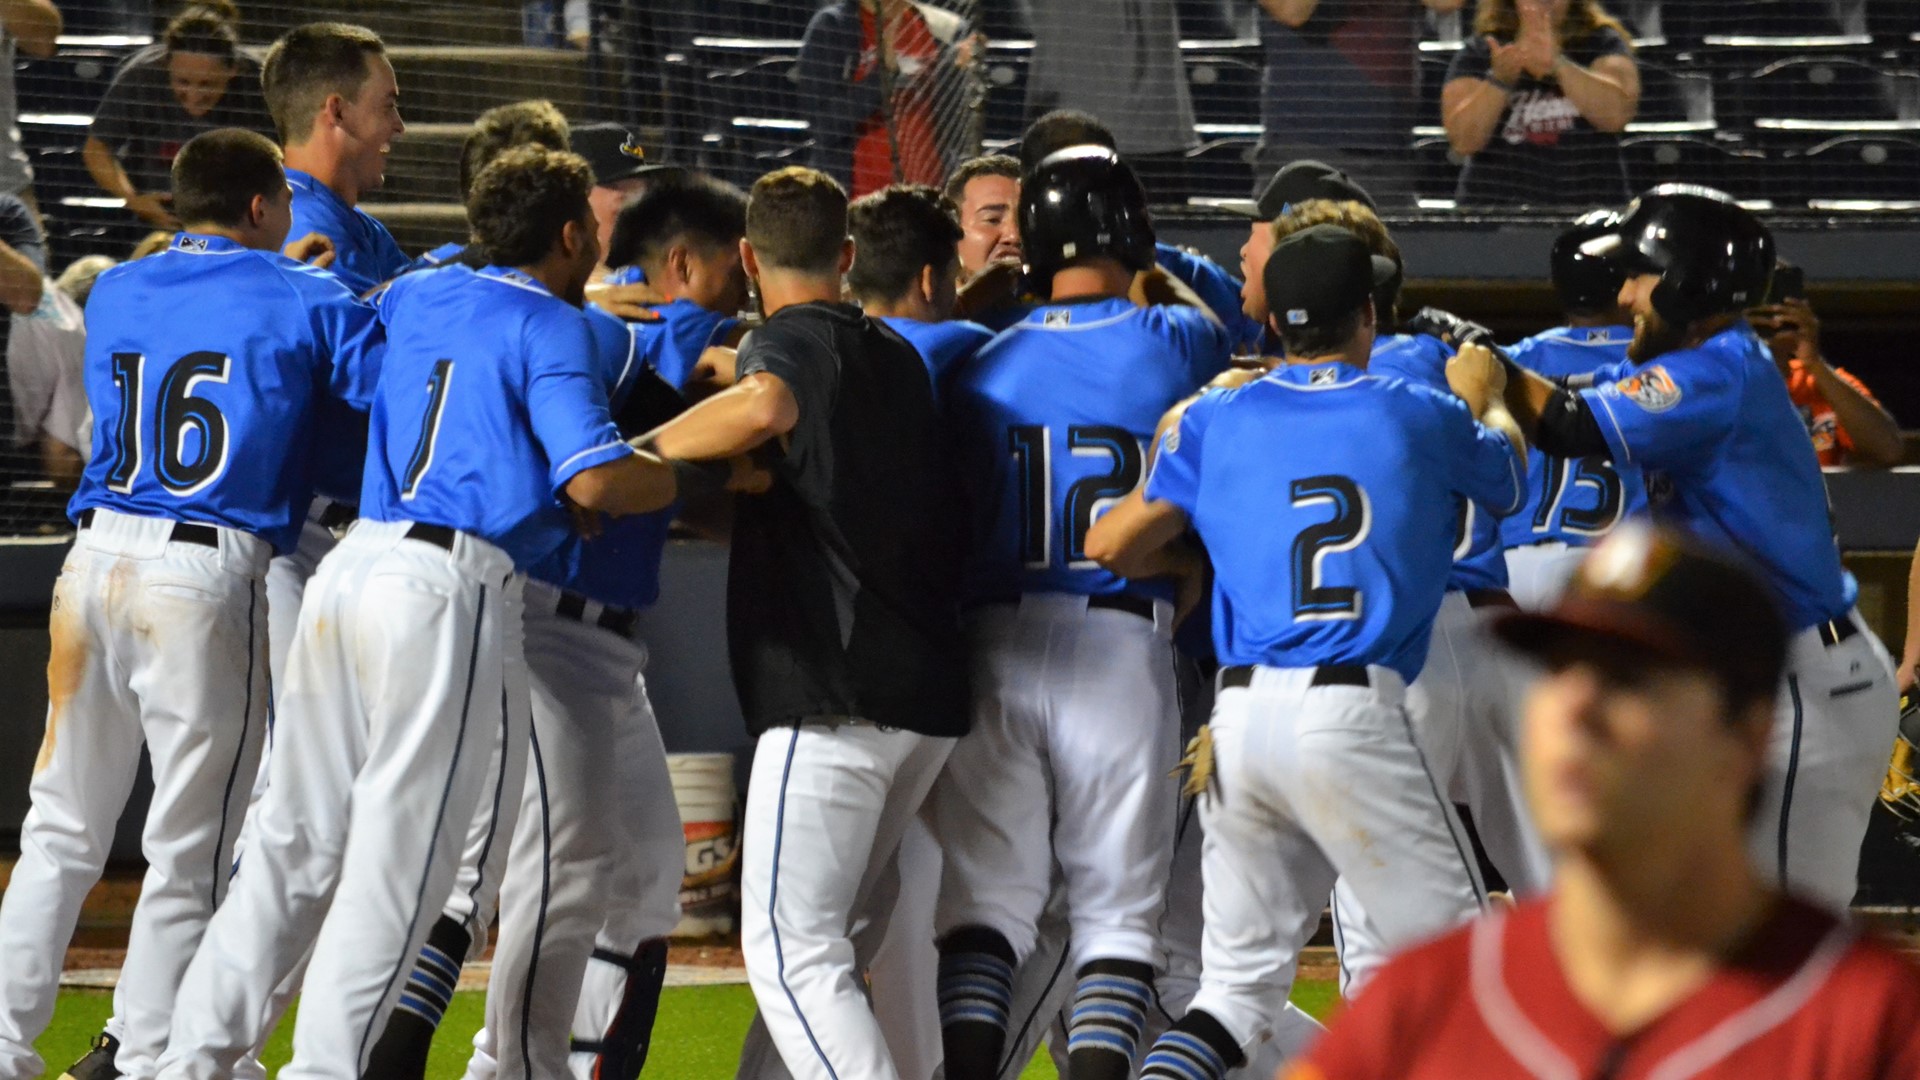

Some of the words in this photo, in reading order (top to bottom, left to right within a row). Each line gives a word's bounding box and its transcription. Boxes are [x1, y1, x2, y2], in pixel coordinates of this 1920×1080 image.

[105, 351, 232, 497] 16
[401, 358, 455, 502] 1
[1007, 424, 1147, 570] 12
[1531, 455, 1625, 536] 15
[1290, 474, 1372, 624] 2
